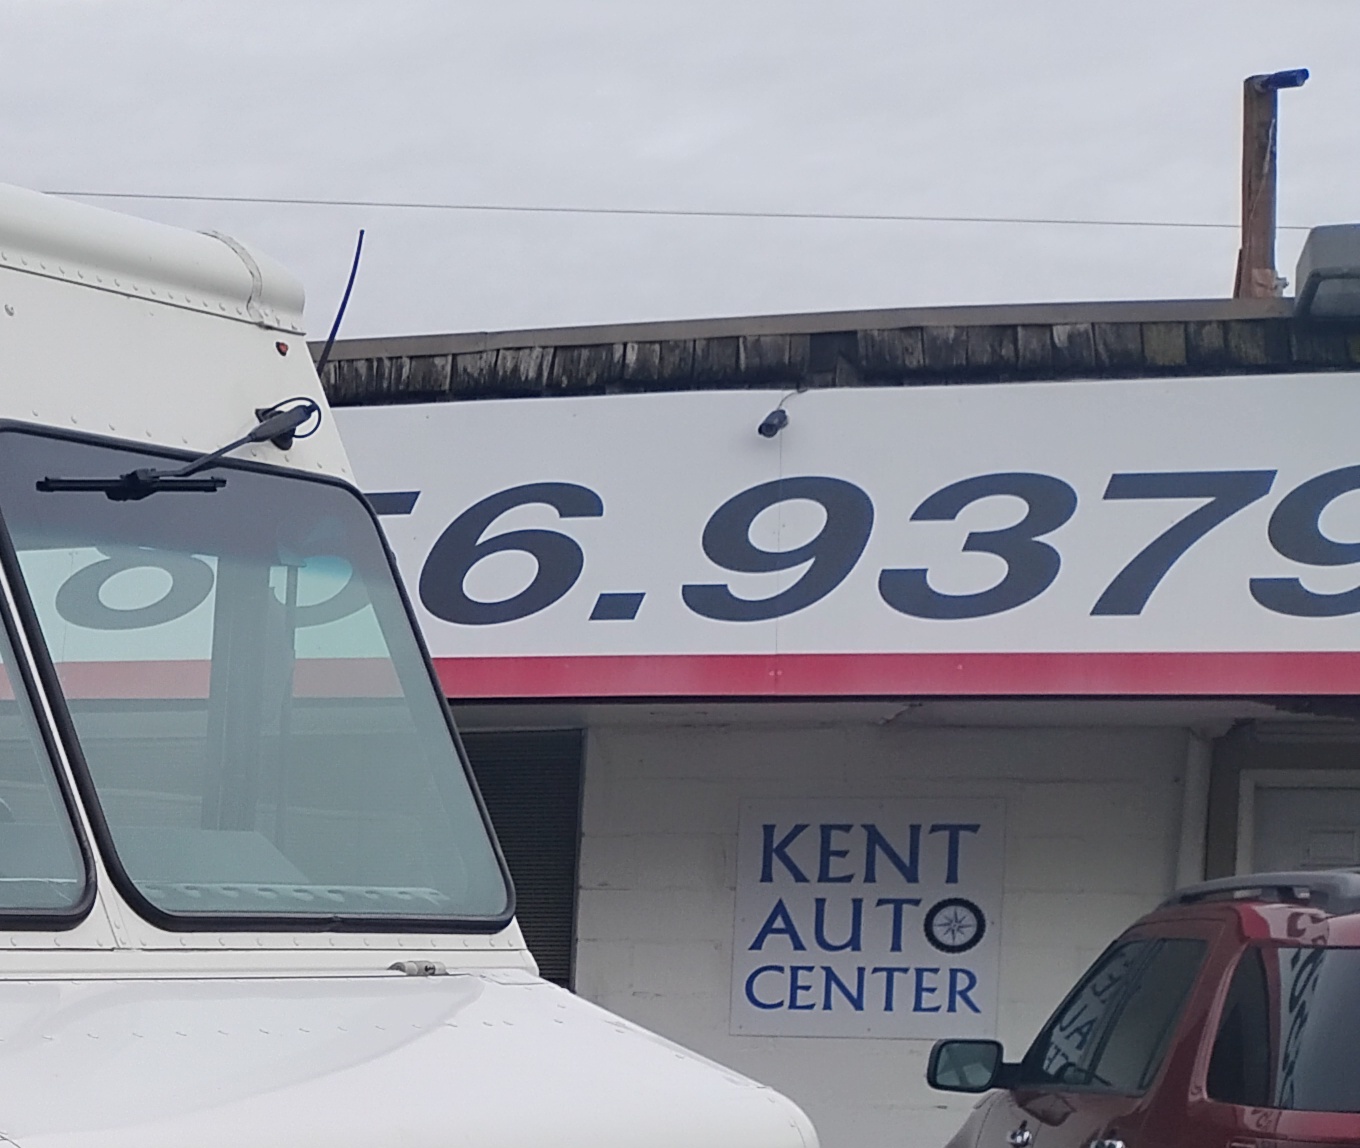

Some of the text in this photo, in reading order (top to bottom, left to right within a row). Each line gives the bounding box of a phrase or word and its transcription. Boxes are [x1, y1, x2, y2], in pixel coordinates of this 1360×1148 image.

[759, 823, 981, 884] KENT
[747, 897, 986, 954] AUTO
[744, 965, 982, 1013] CENTER
